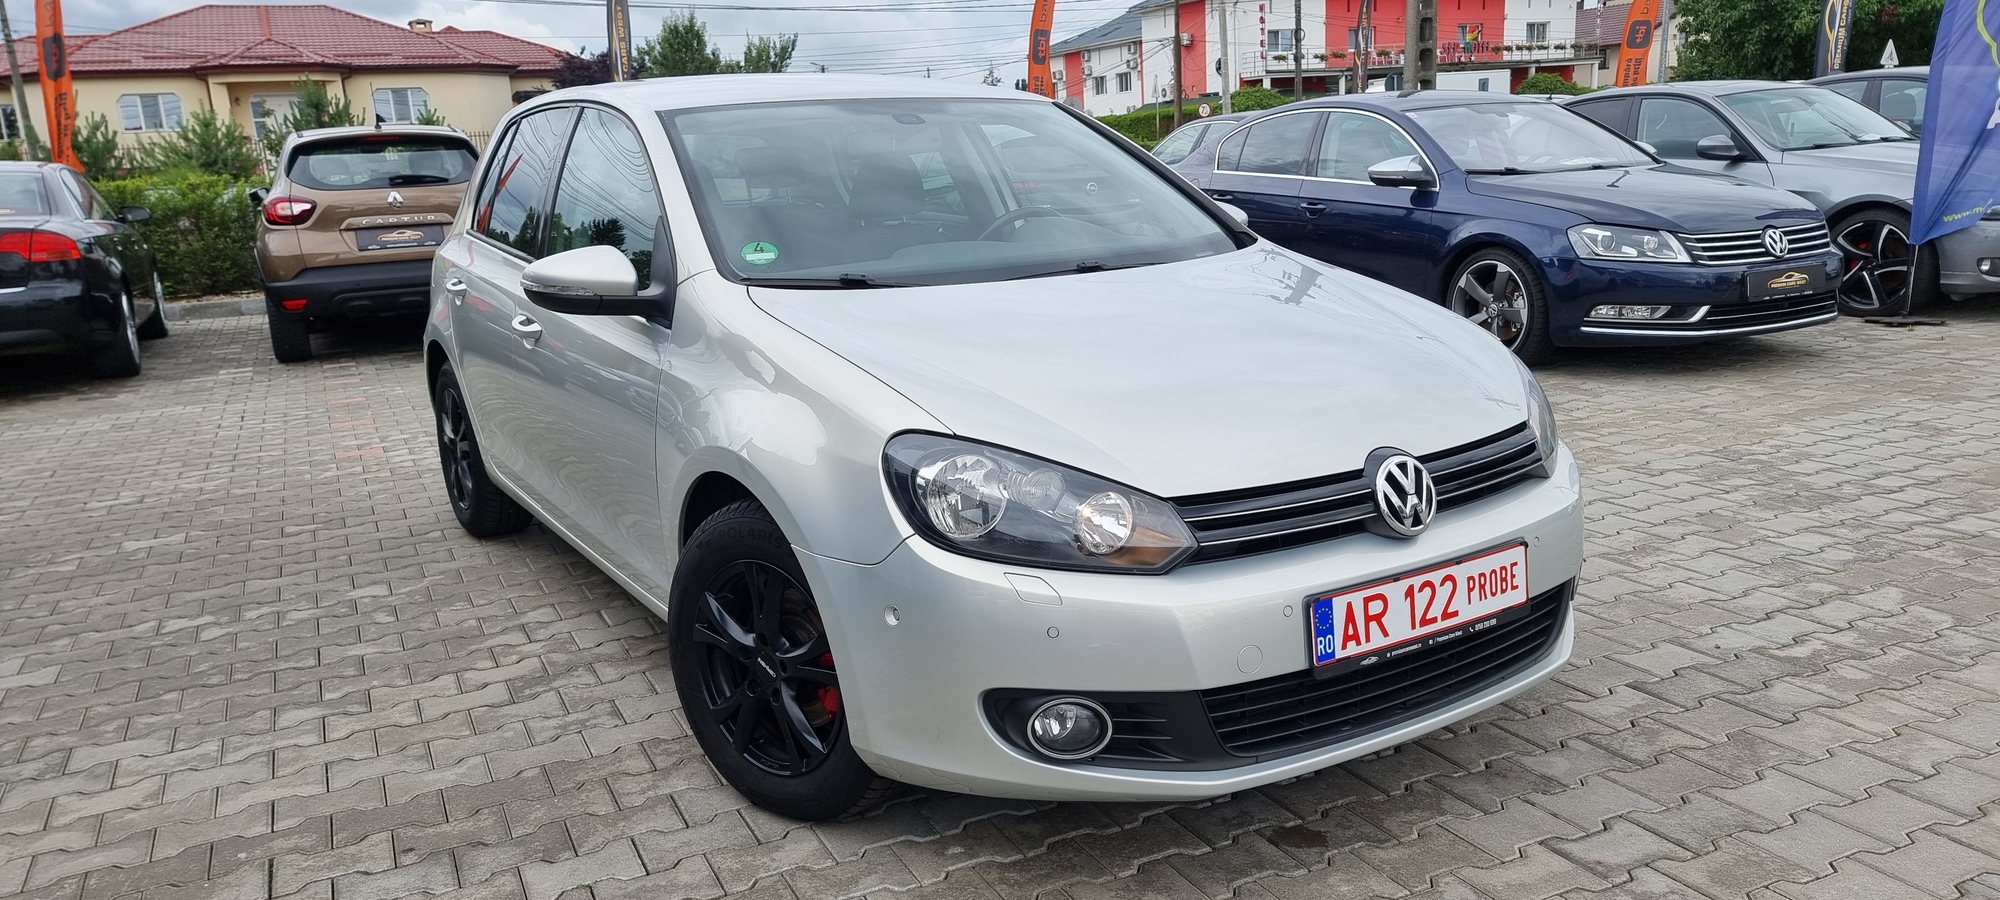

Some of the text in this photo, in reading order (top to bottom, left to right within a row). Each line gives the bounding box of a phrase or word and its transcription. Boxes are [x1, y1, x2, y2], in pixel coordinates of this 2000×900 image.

[616, 5, 625, 38] WEST
[1635, 26, 1647, 43] tbi
[620, 41, 629, 72] CARS
[1038, 36, 1046, 58] tbi
[1834, 28, 1846, 69] PREMIUM
[362, 215, 435, 225] CAPTUR
[754, 243, 765, 253] 4
[718, 526, 783, 549] POLARIS
[1317, 561, 1519, 657] RO AR 122 PROBE
